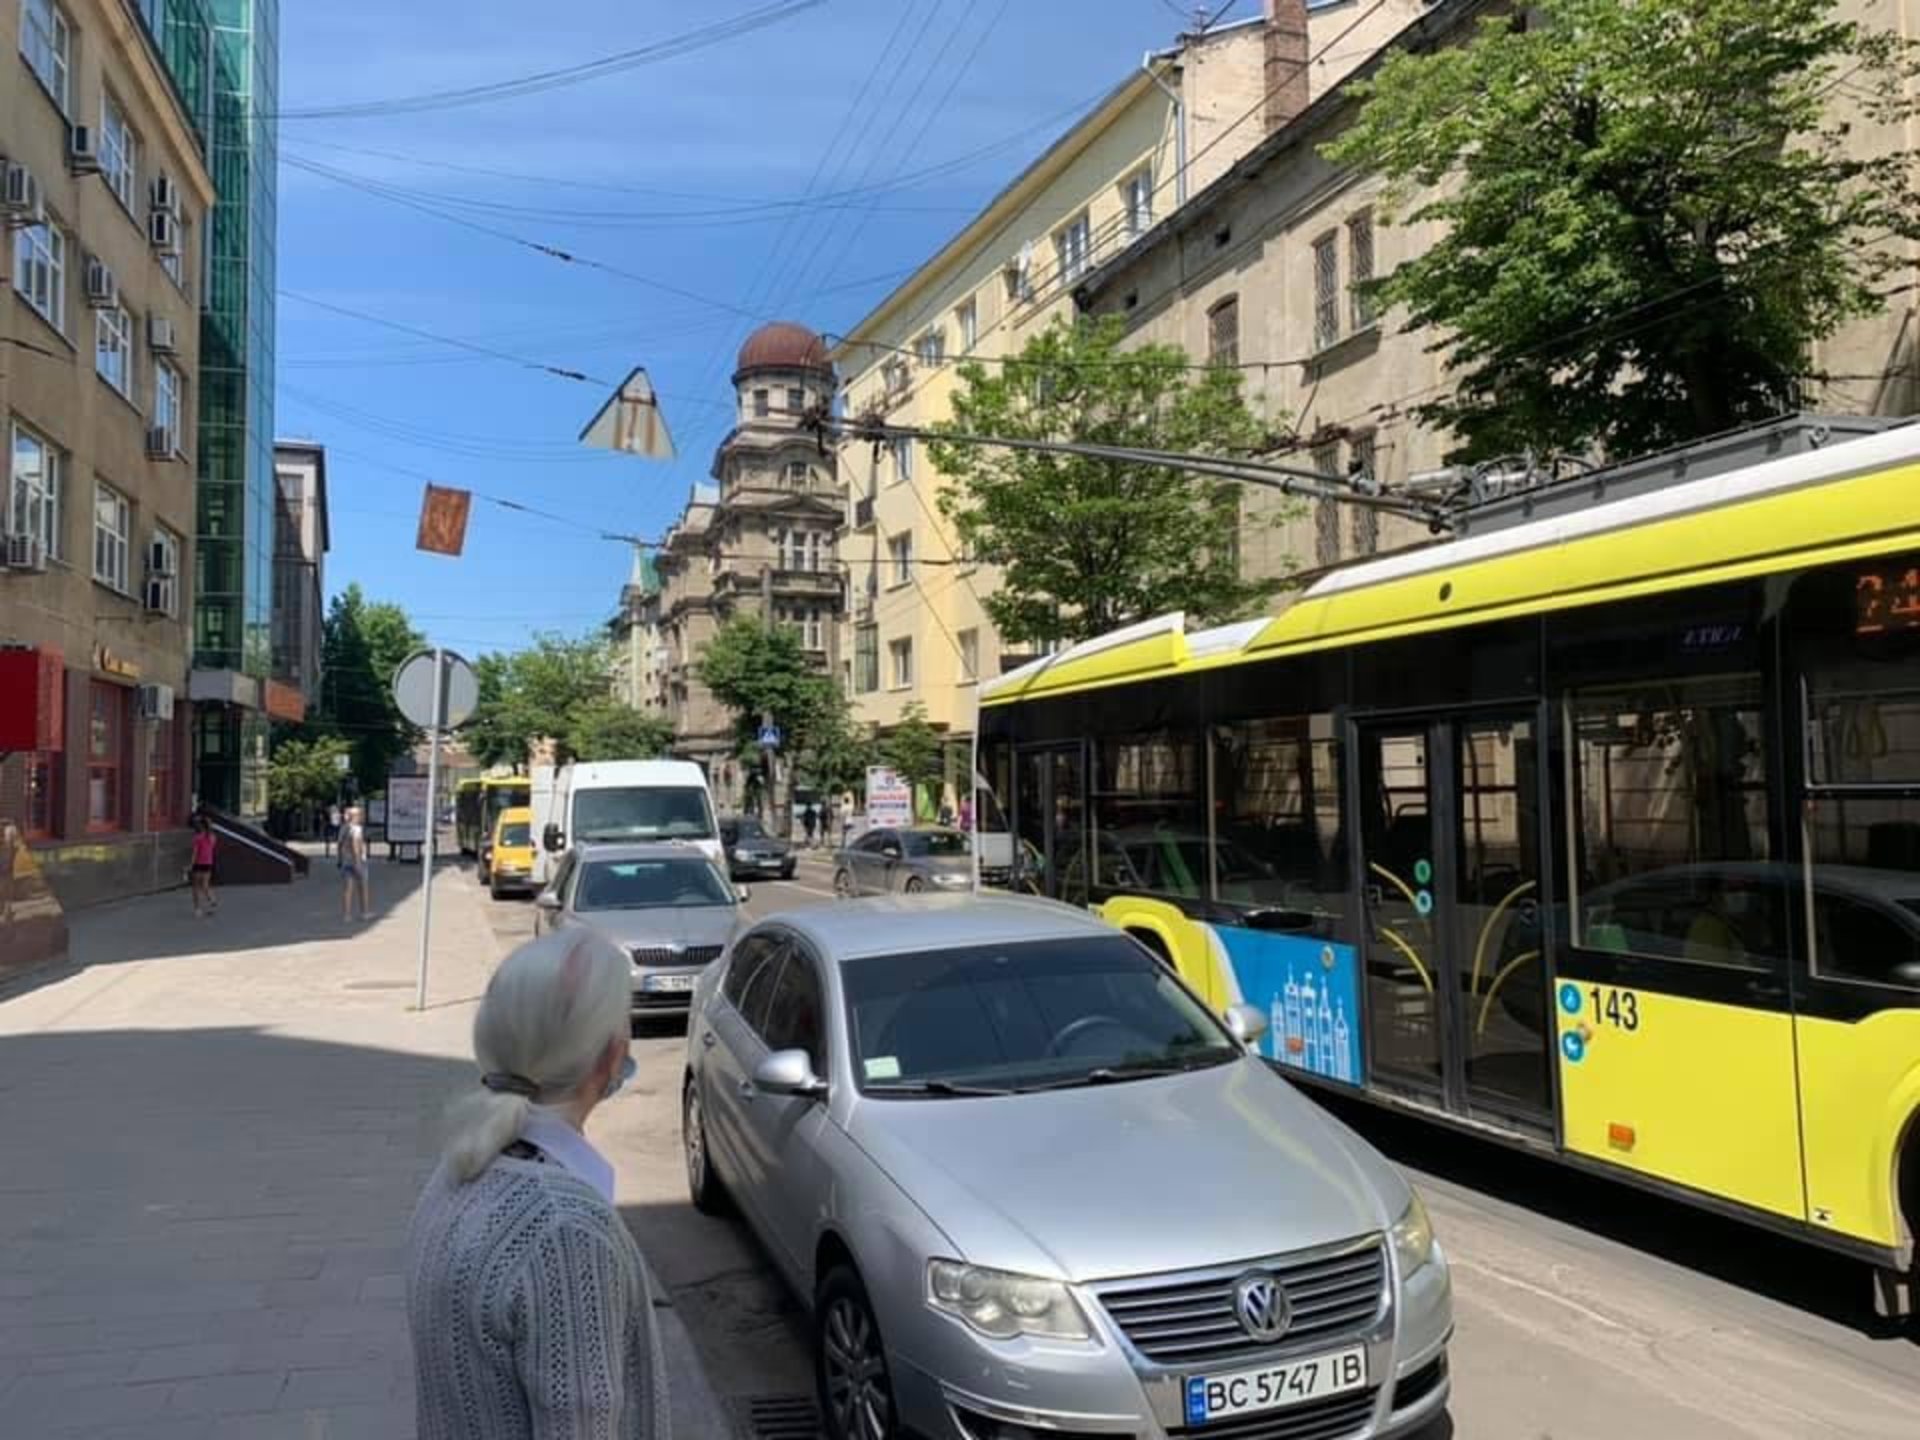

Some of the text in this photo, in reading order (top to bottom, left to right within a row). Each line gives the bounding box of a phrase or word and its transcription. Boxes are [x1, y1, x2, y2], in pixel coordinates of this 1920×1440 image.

[1590, 987, 1638, 1030] 143
[1206, 1354, 1361, 1412] BC 5747 IB
